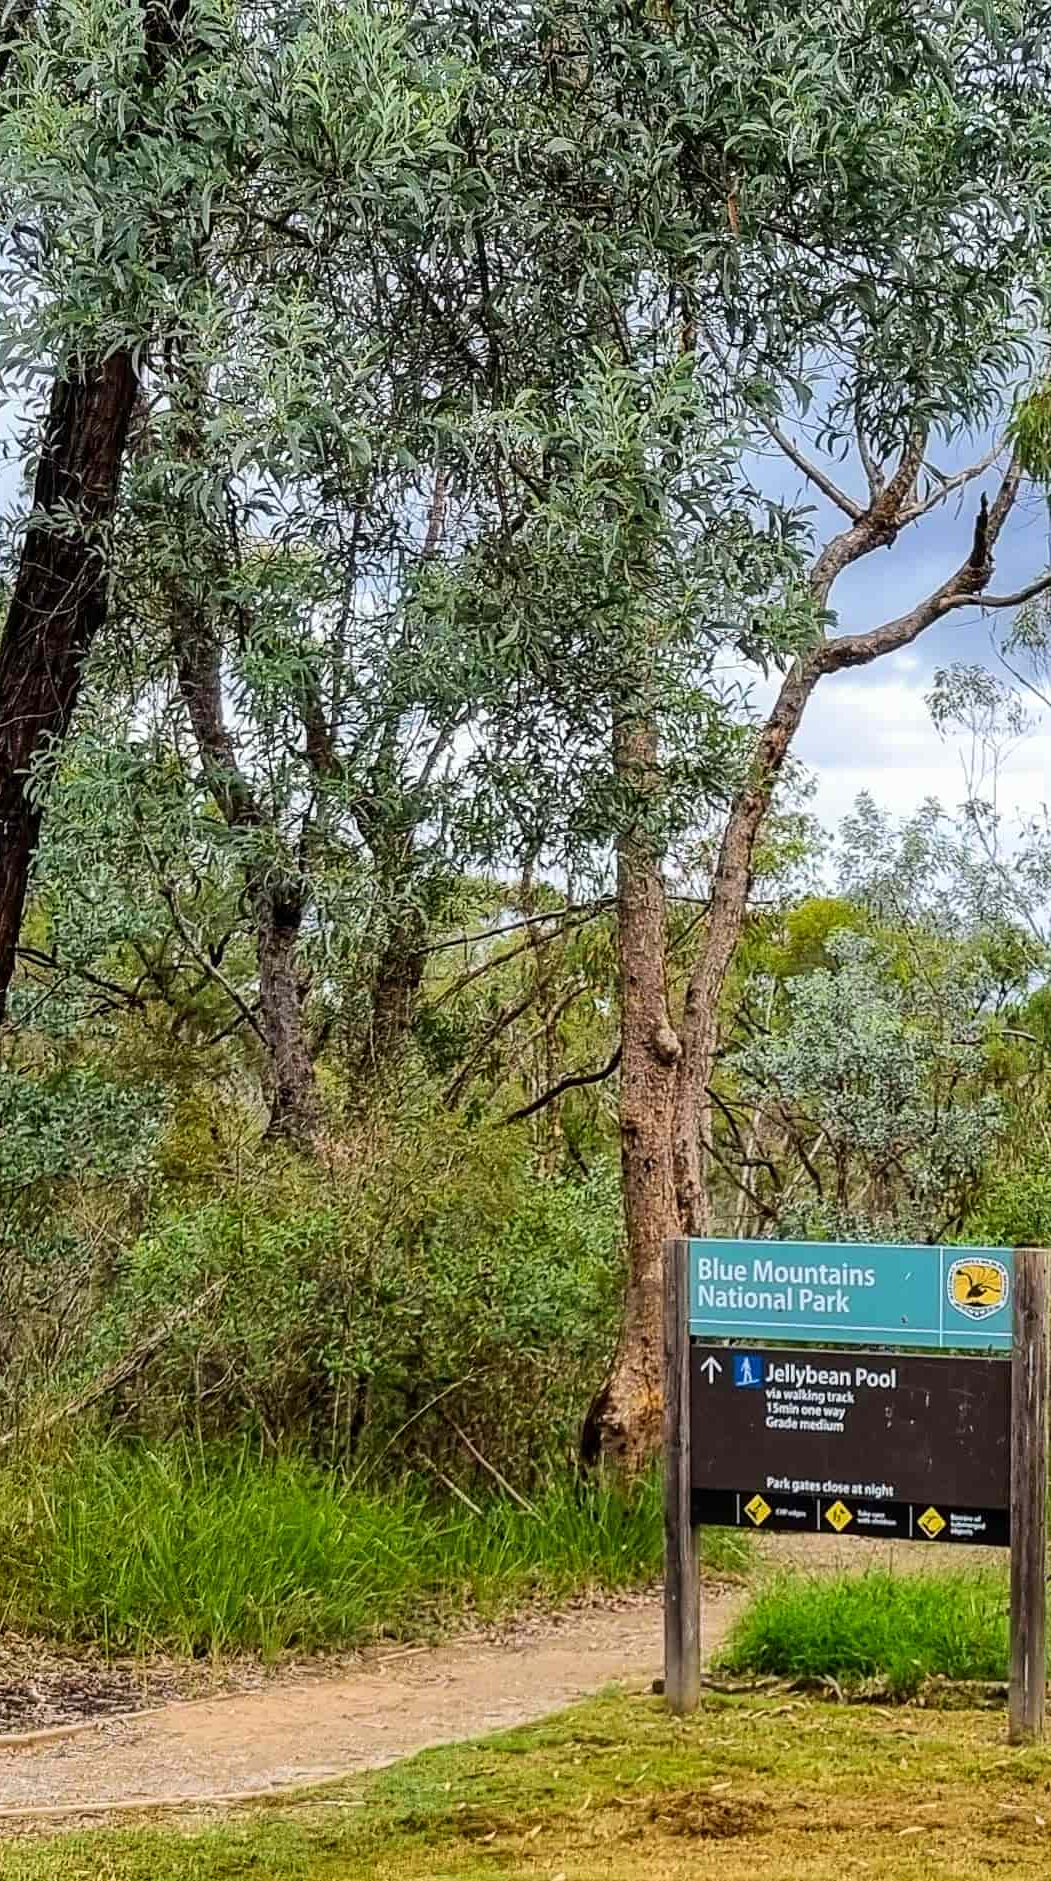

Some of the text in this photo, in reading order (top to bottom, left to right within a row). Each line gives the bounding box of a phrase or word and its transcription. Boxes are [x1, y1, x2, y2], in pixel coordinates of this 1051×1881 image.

[698, 1257, 875, 1287] Blue Mountains
[698, 1285, 850, 1313] National Park
[766, 1363, 897, 1388] Jellybean Pool
[765, 1388, 855, 1404] via walking track
[767, 1402, 846, 1420] 15min one way
[765, 1416, 844, 1432] Grade medium
[766, 1476, 894, 1499] Park gates close at night
